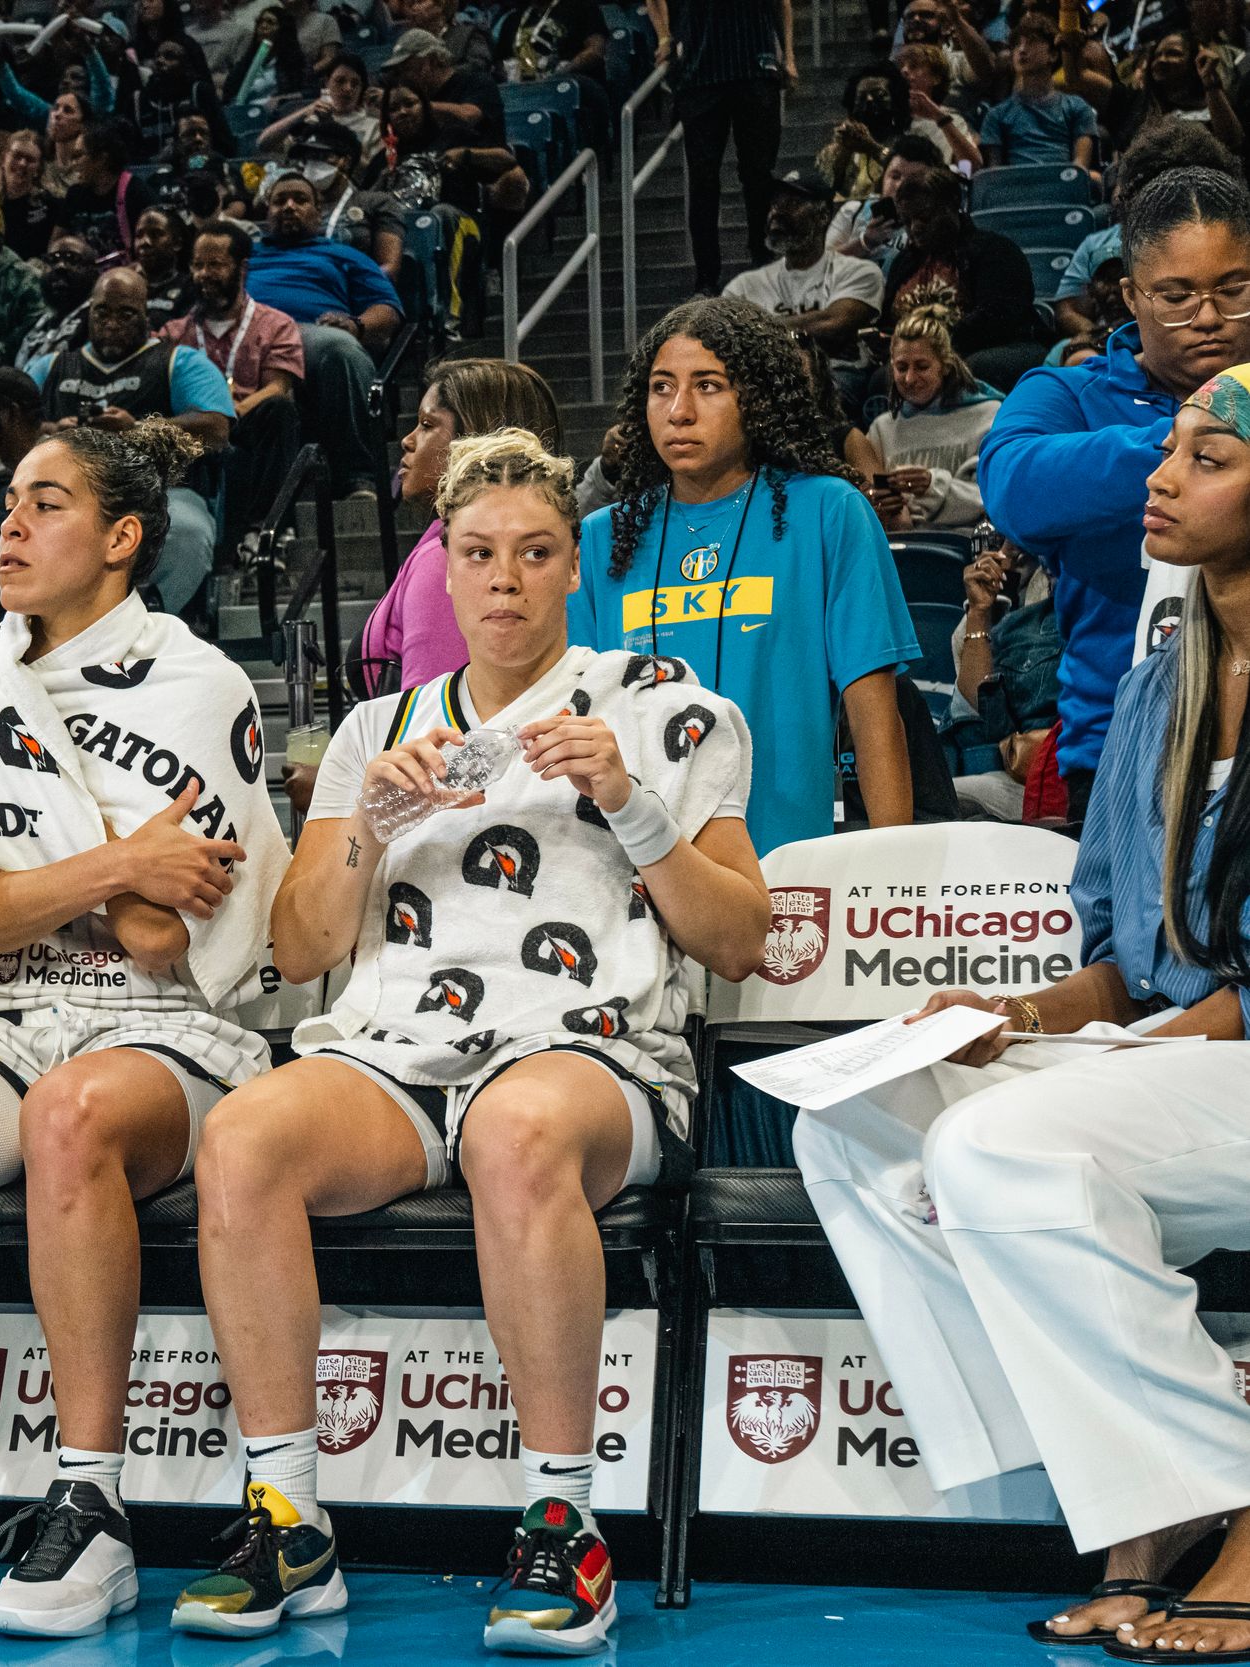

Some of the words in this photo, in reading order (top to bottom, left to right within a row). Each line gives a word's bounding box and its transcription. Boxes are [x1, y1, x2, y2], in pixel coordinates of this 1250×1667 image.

[649, 584, 741, 618] SKY
[848, 886, 873, 897] AT
[887, 886, 927, 898] THE
[941, 883, 1071, 897] FOREFRONT
[847, 904, 1073, 943] UChicago
[845, 945, 1073, 986] Medicine
[25, 965, 127, 987] Medicine
[23, 1347, 47, 1360] AT
[404, 1351, 429, 1363] AT
[444, 1351, 484, 1364] THE
[840, 1355, 867, 1368] AT
